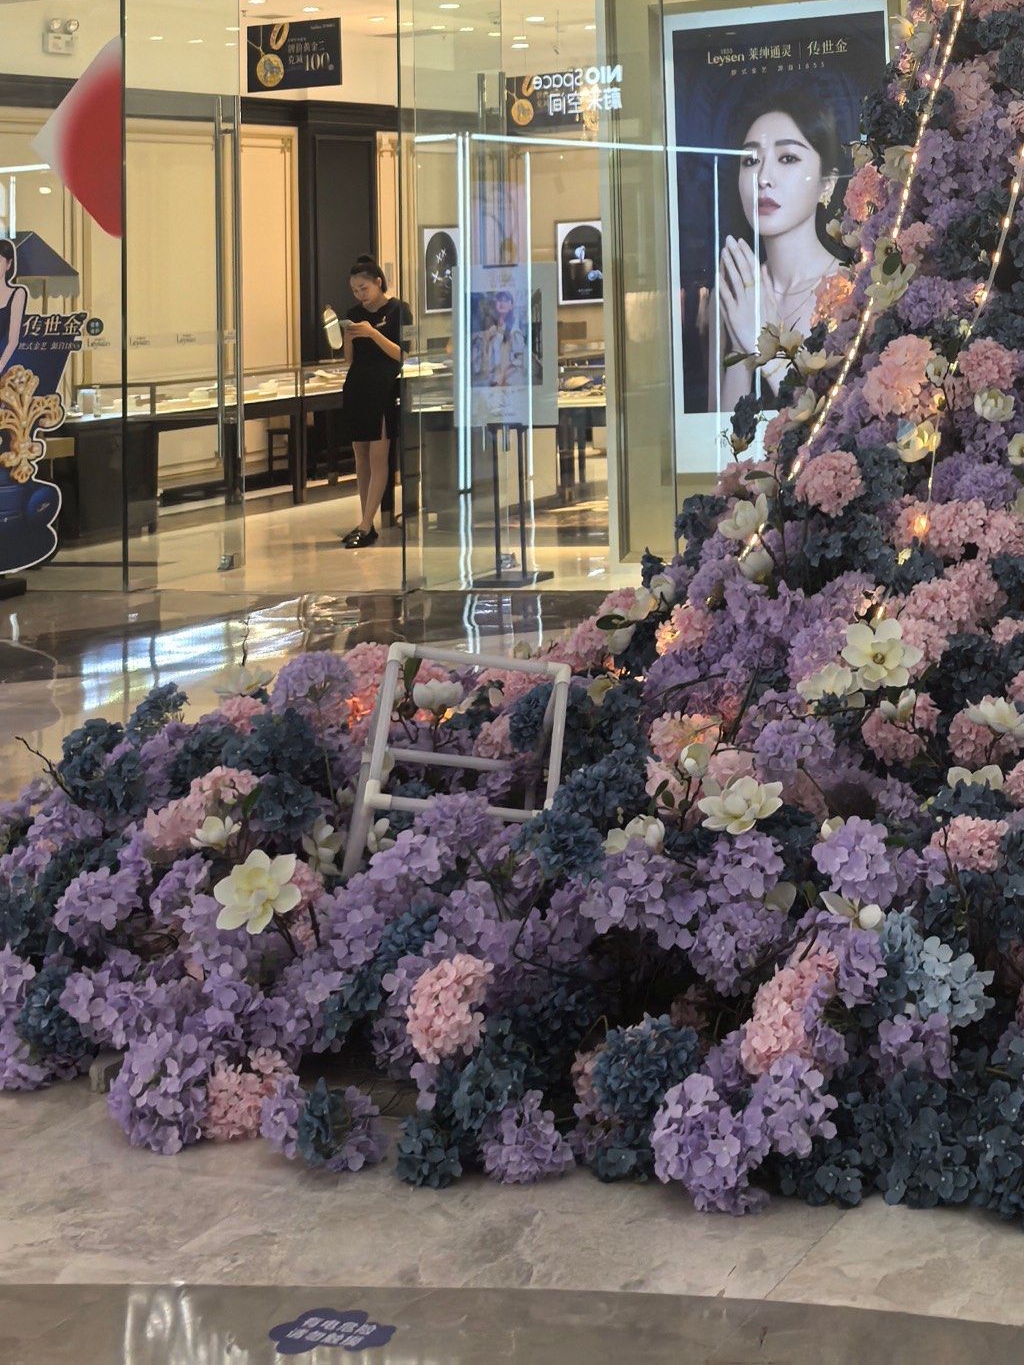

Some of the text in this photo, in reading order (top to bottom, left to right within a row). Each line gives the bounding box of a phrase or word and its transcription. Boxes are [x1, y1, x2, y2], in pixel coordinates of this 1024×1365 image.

[707, 38, 848, 66] Leysen 莱绅通灵 传世金
[22, 315, 81, 337] 传世金
